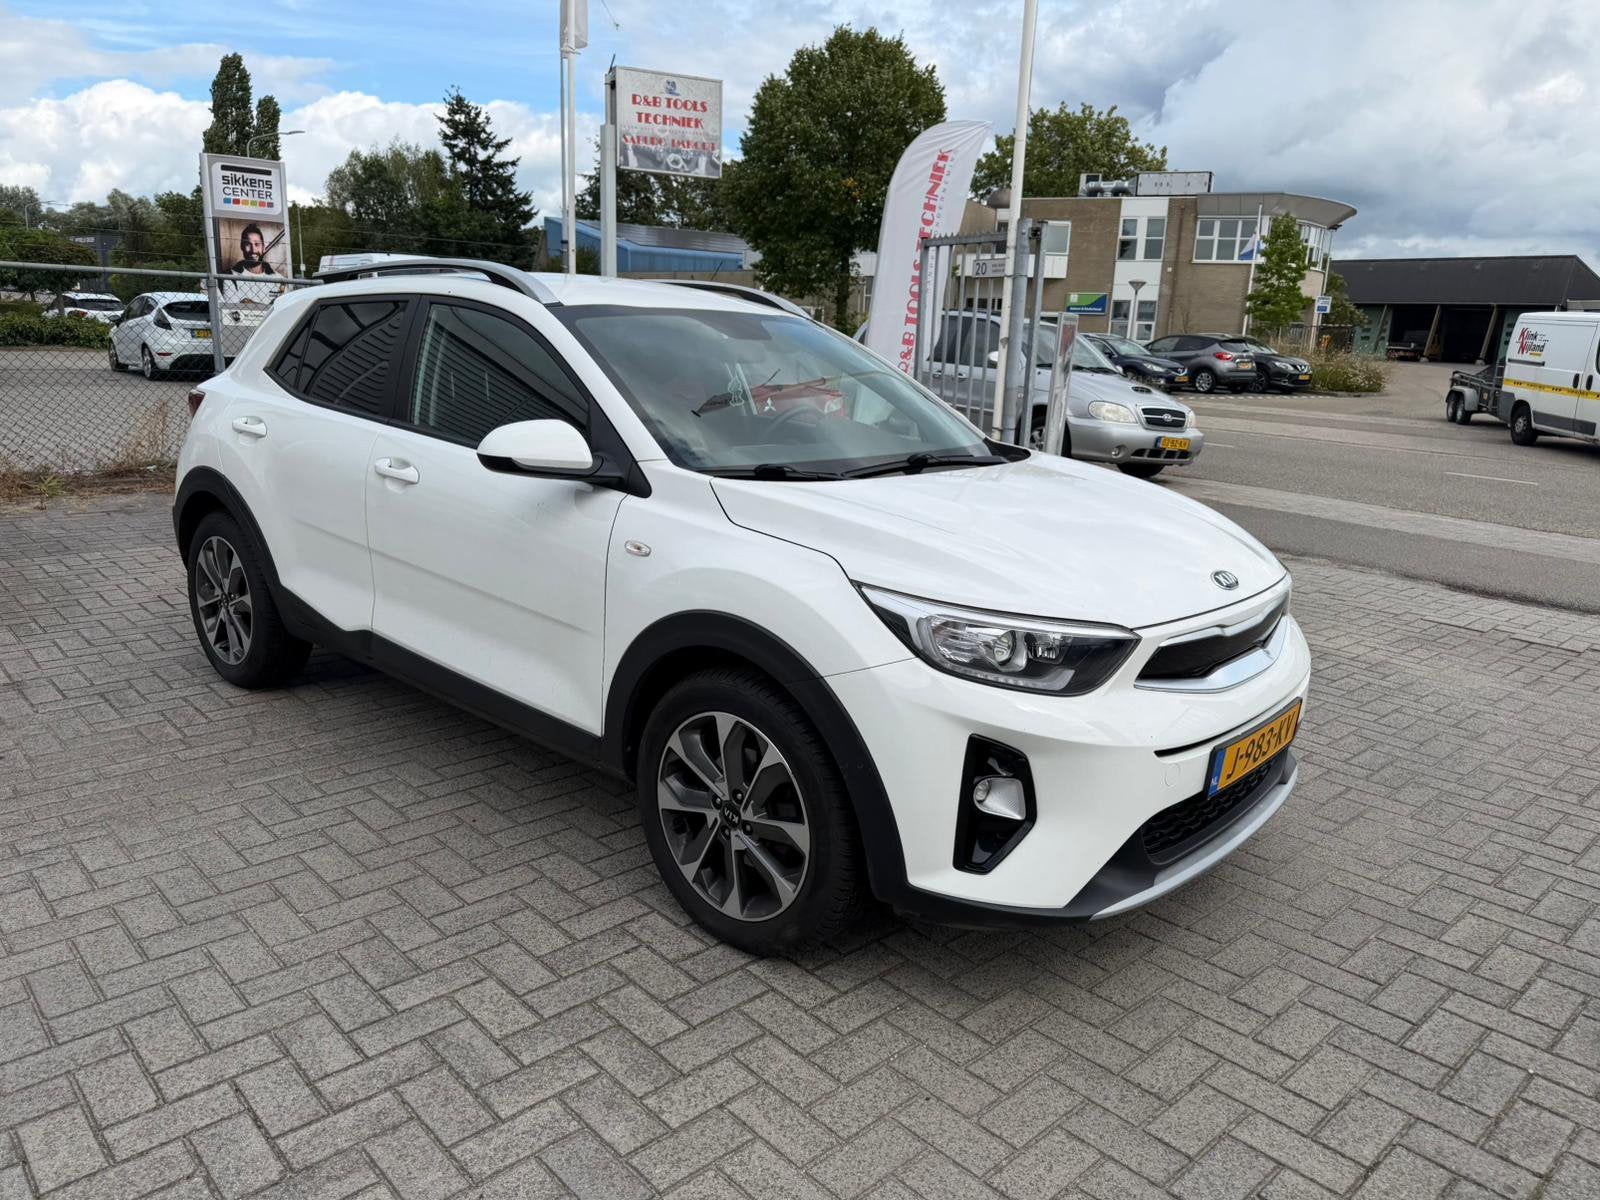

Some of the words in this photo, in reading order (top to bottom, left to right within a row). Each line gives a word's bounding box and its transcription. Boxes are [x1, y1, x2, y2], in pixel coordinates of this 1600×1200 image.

[631, 94, 661, 108] R&B
[665, 97, 708, 113] TOOLS
[636, 112, 704, 130] TECHNIEK
[221, 173, 273, 190] sikkens
[222, 186, 273, 201] CENTER
[975, 262, 988, 276] 20
[1225, 710, 1297, 780] J-983-KV
